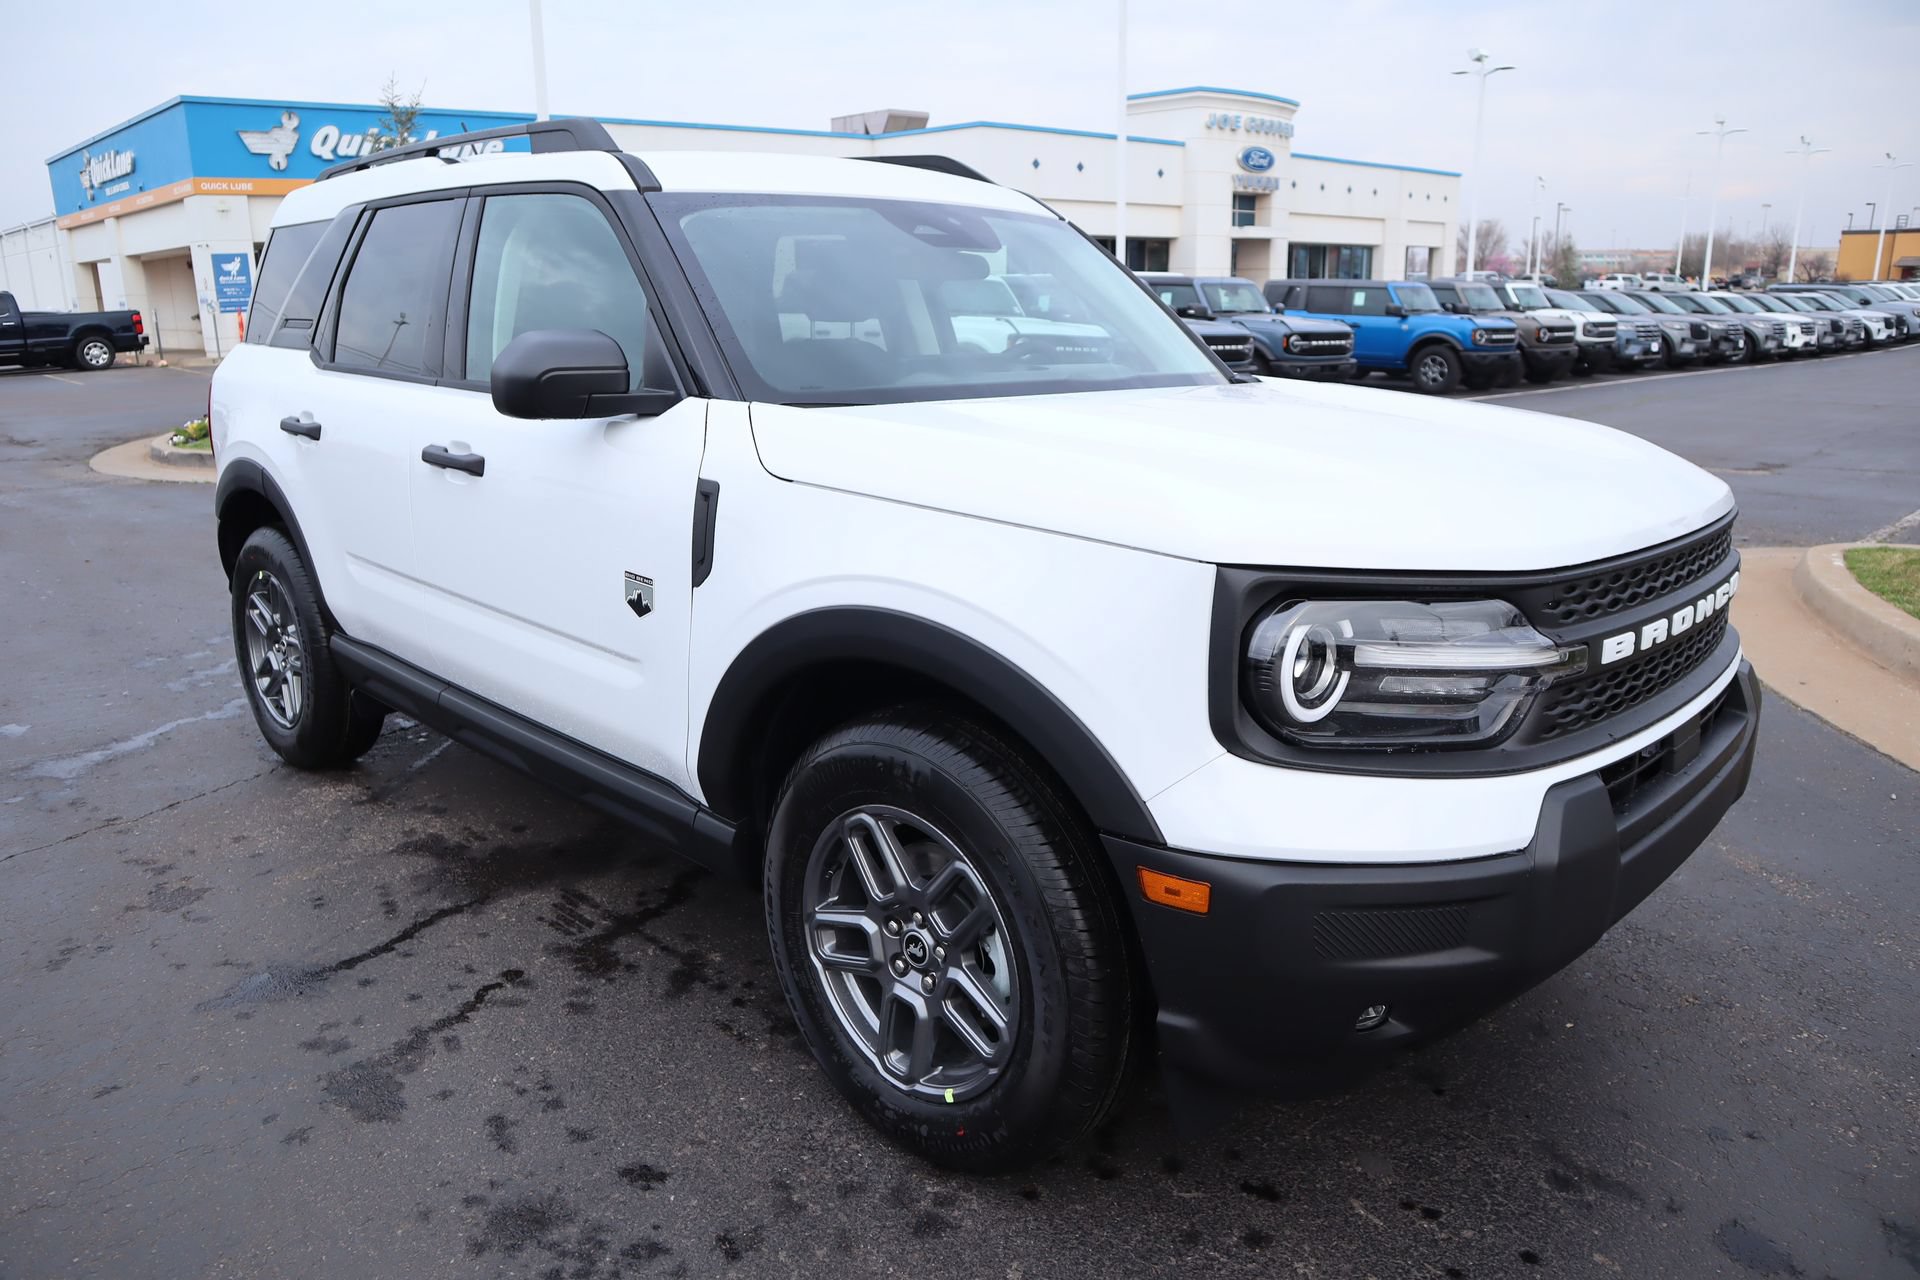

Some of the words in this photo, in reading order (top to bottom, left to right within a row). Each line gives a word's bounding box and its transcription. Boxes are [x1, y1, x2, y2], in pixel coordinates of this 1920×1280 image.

[1205, 112, 1242, 131] JOE
[200, 182, 229, 191] QUICK
[230, 182, 253, 191] LUBE
[625, 572, 636, 580] BIG
[636, 575, 653, 585] BEND
